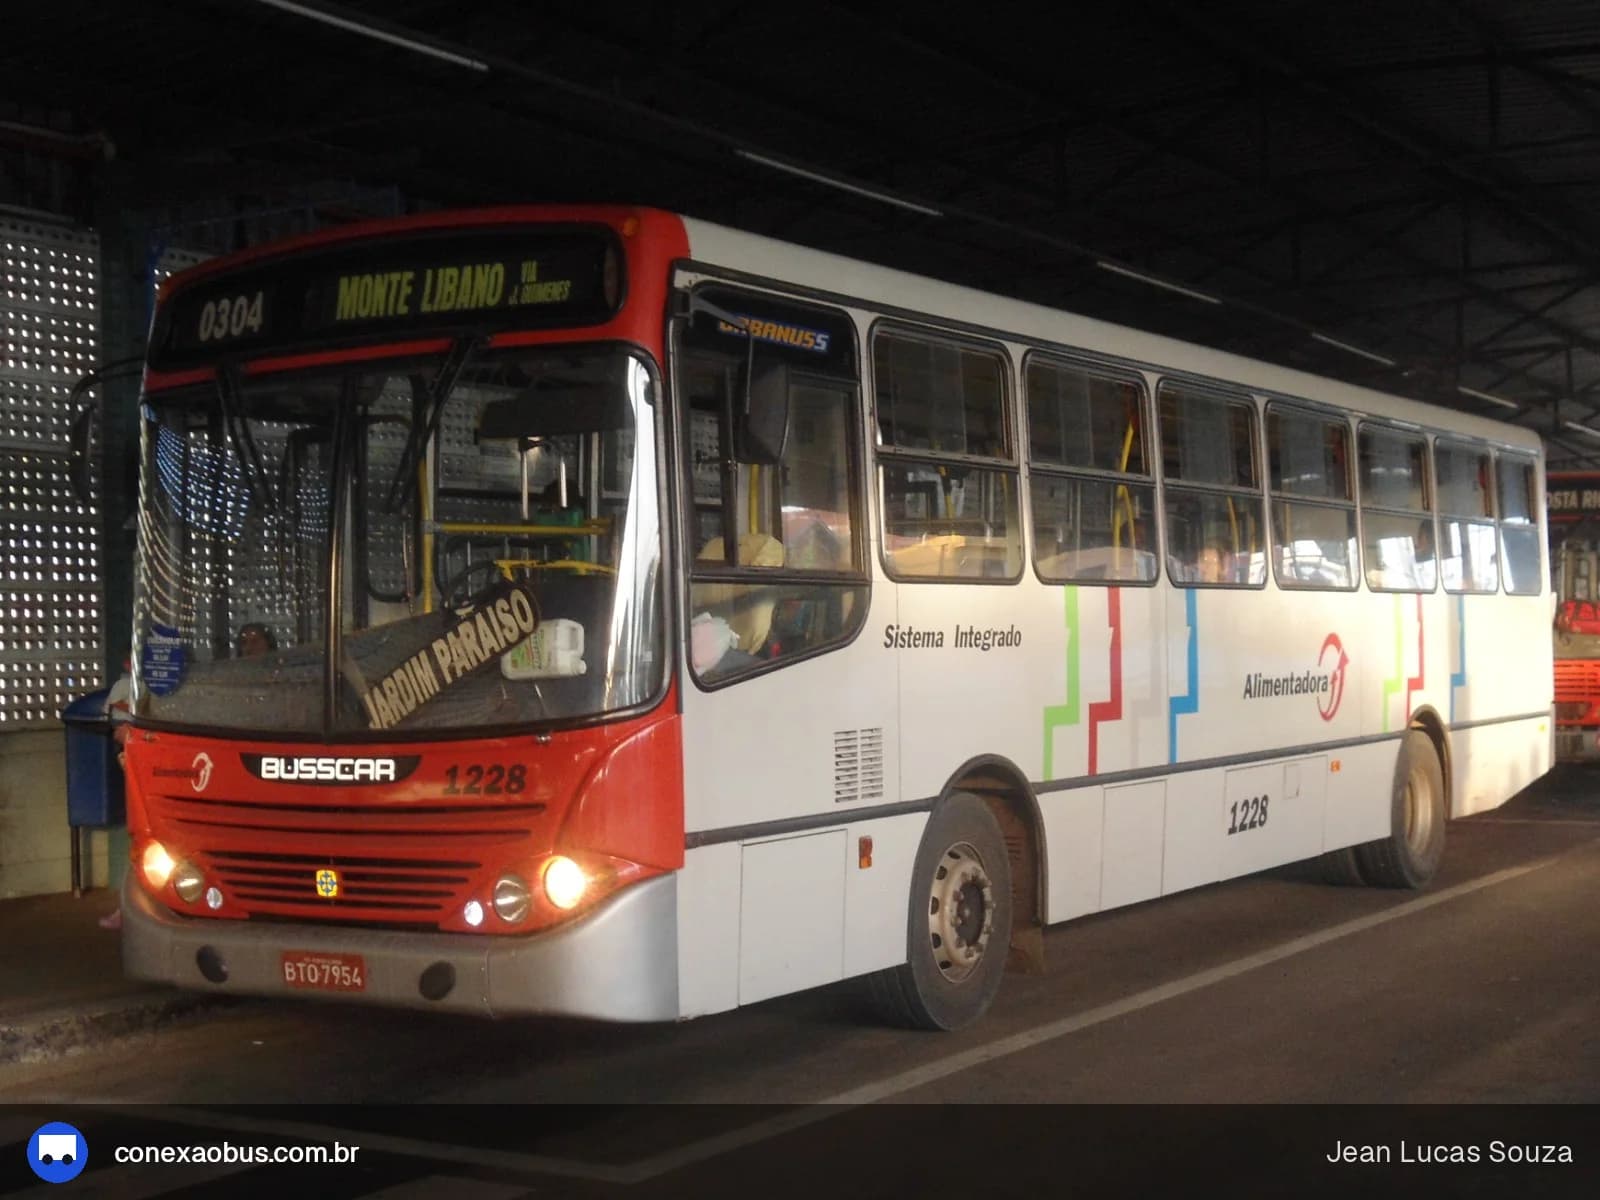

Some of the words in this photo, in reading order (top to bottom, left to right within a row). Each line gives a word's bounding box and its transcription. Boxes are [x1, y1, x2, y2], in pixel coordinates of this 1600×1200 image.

[335, 271, 415, 321] MONTE
[420, 262, 504, 312] LIBANO
[199, 290, 264, 341] 0304
[883, 623, 945, 649] Sistema
[954, 624, 1022, 651] Integrado
[364, 650, 440, 729] JARDIM
[432, 588, 535, 684] PARAISO
[1243, 670, 1329, 700] Alimentadora
[260, 757, 395, 782] BUSSCAR
[442, 764, 527, 795] 1228
[1228, 794, 1269, 835] 1228
